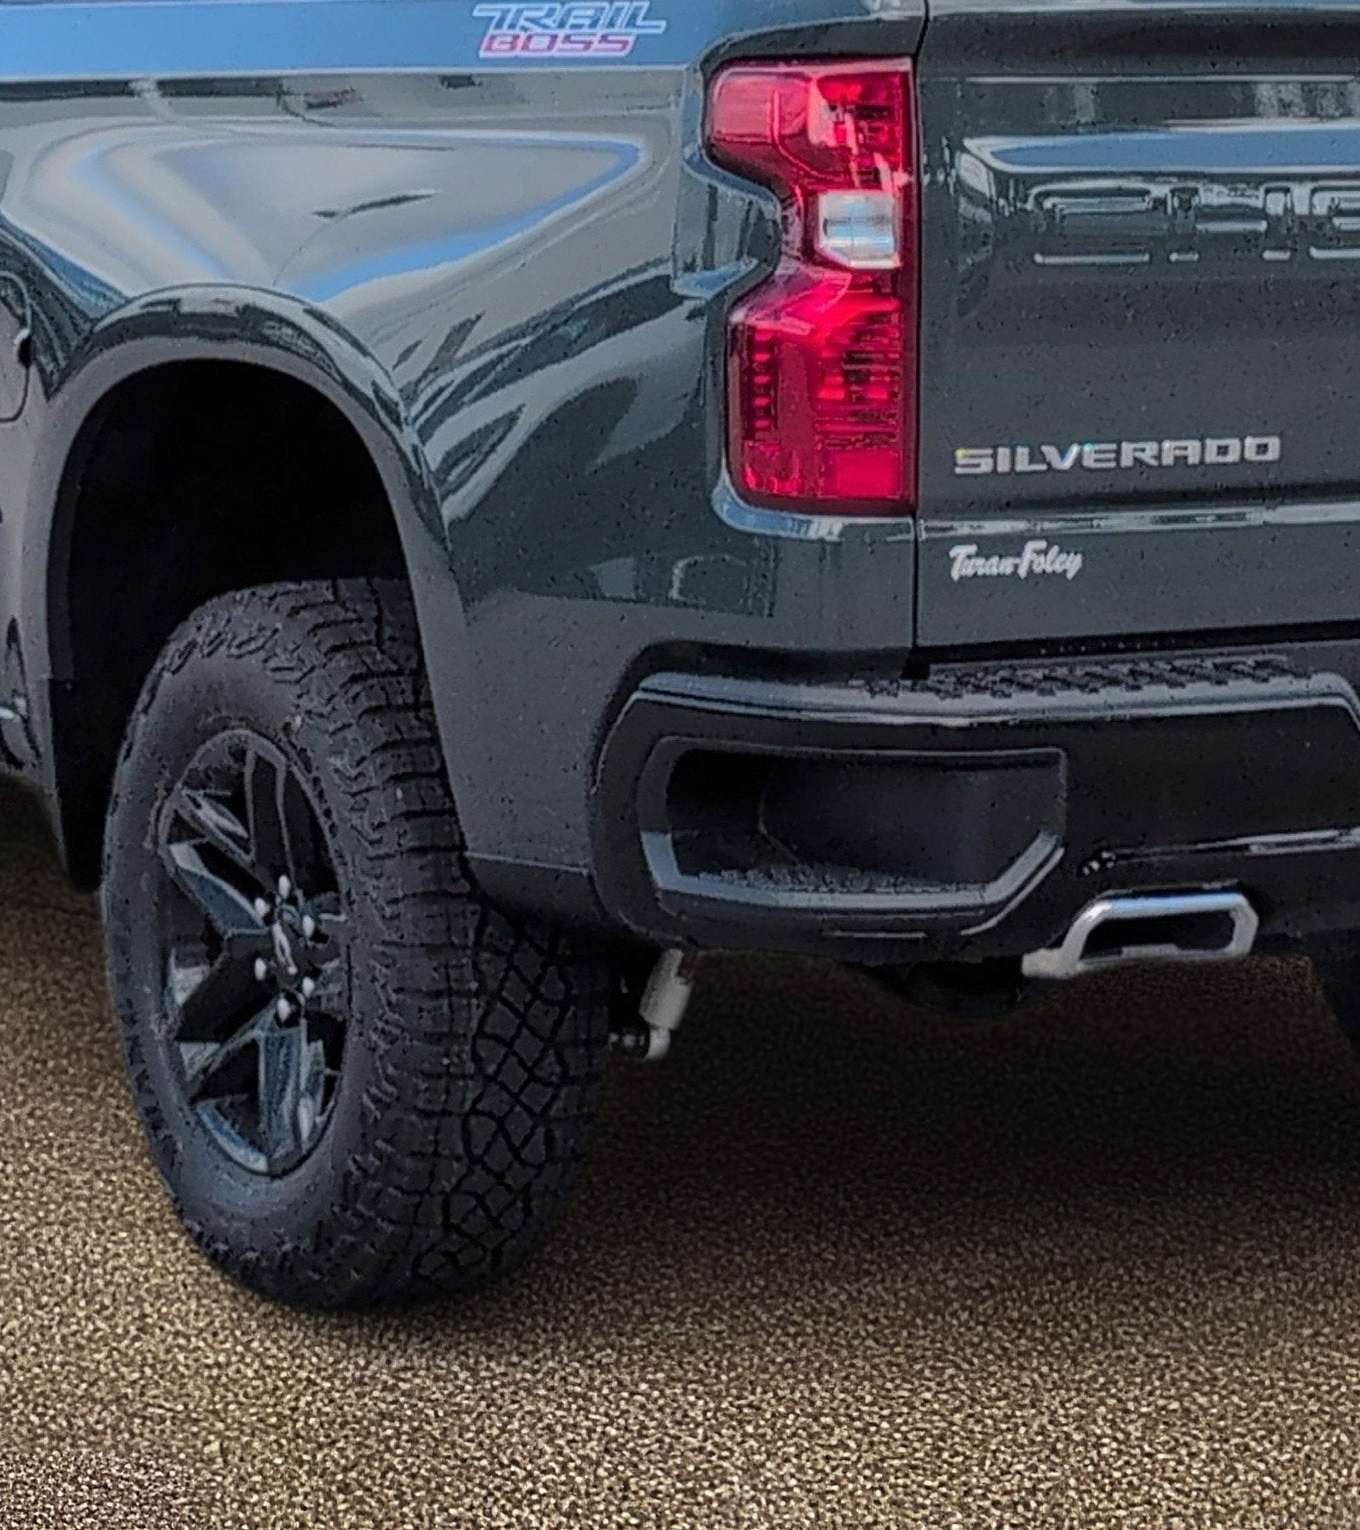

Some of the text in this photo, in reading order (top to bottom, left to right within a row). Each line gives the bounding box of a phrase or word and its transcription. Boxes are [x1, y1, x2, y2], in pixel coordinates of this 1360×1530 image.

[472, 0, 667, 34] TRAIL
[478, 33, 637, 59] BOSS
[954, 435, 1282, 475] SILVERADO
